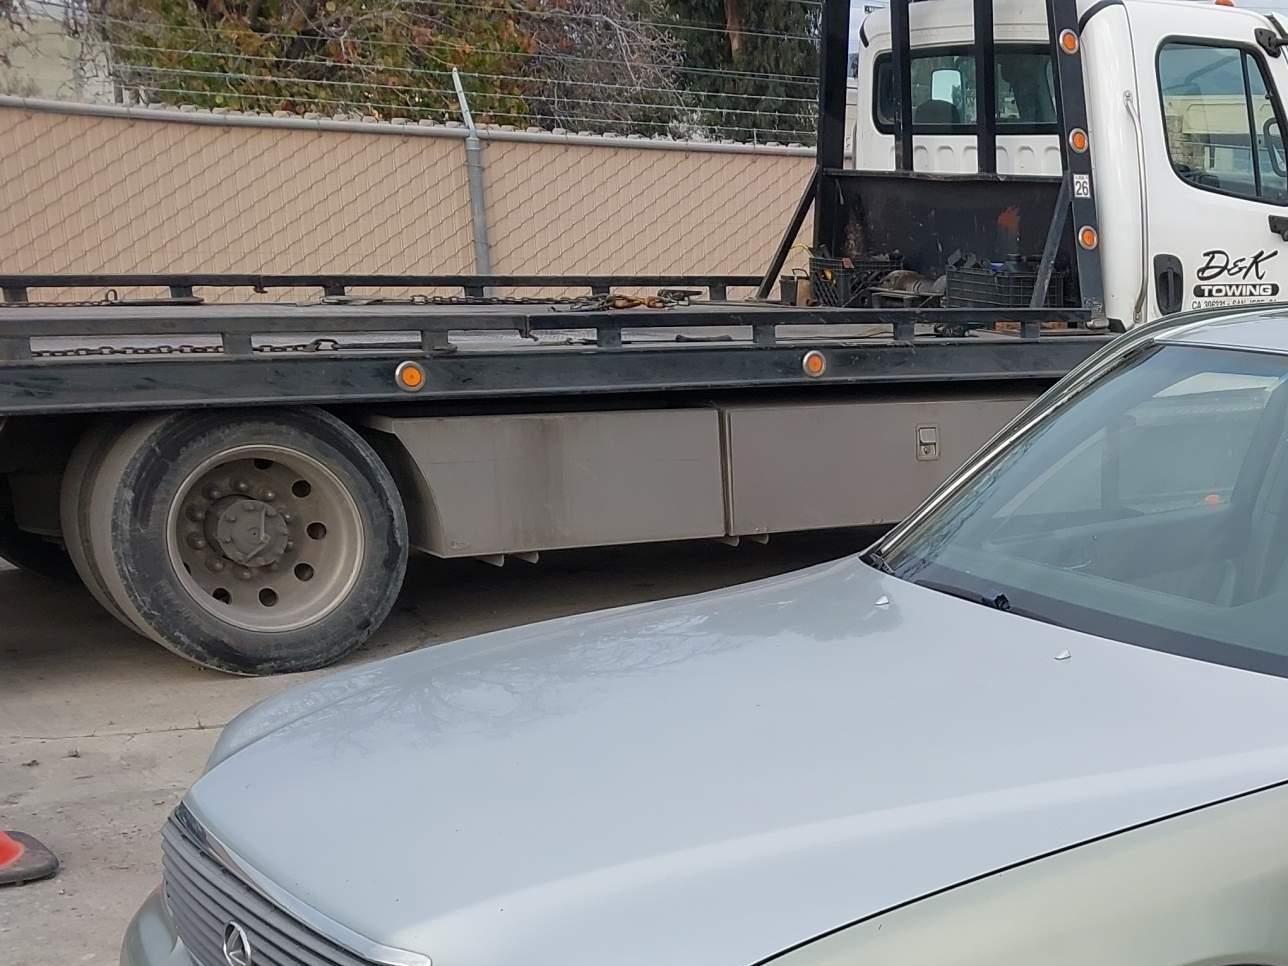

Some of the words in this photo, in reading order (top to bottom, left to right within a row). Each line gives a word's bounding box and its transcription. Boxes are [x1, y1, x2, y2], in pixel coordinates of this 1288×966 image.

[1075, 180, 1089, 196] 26
[1196, 250, 1279, 281] D&K
[1200, 285, 1273, 297] TOWING
[1192, 300, 1202, 310] CA
